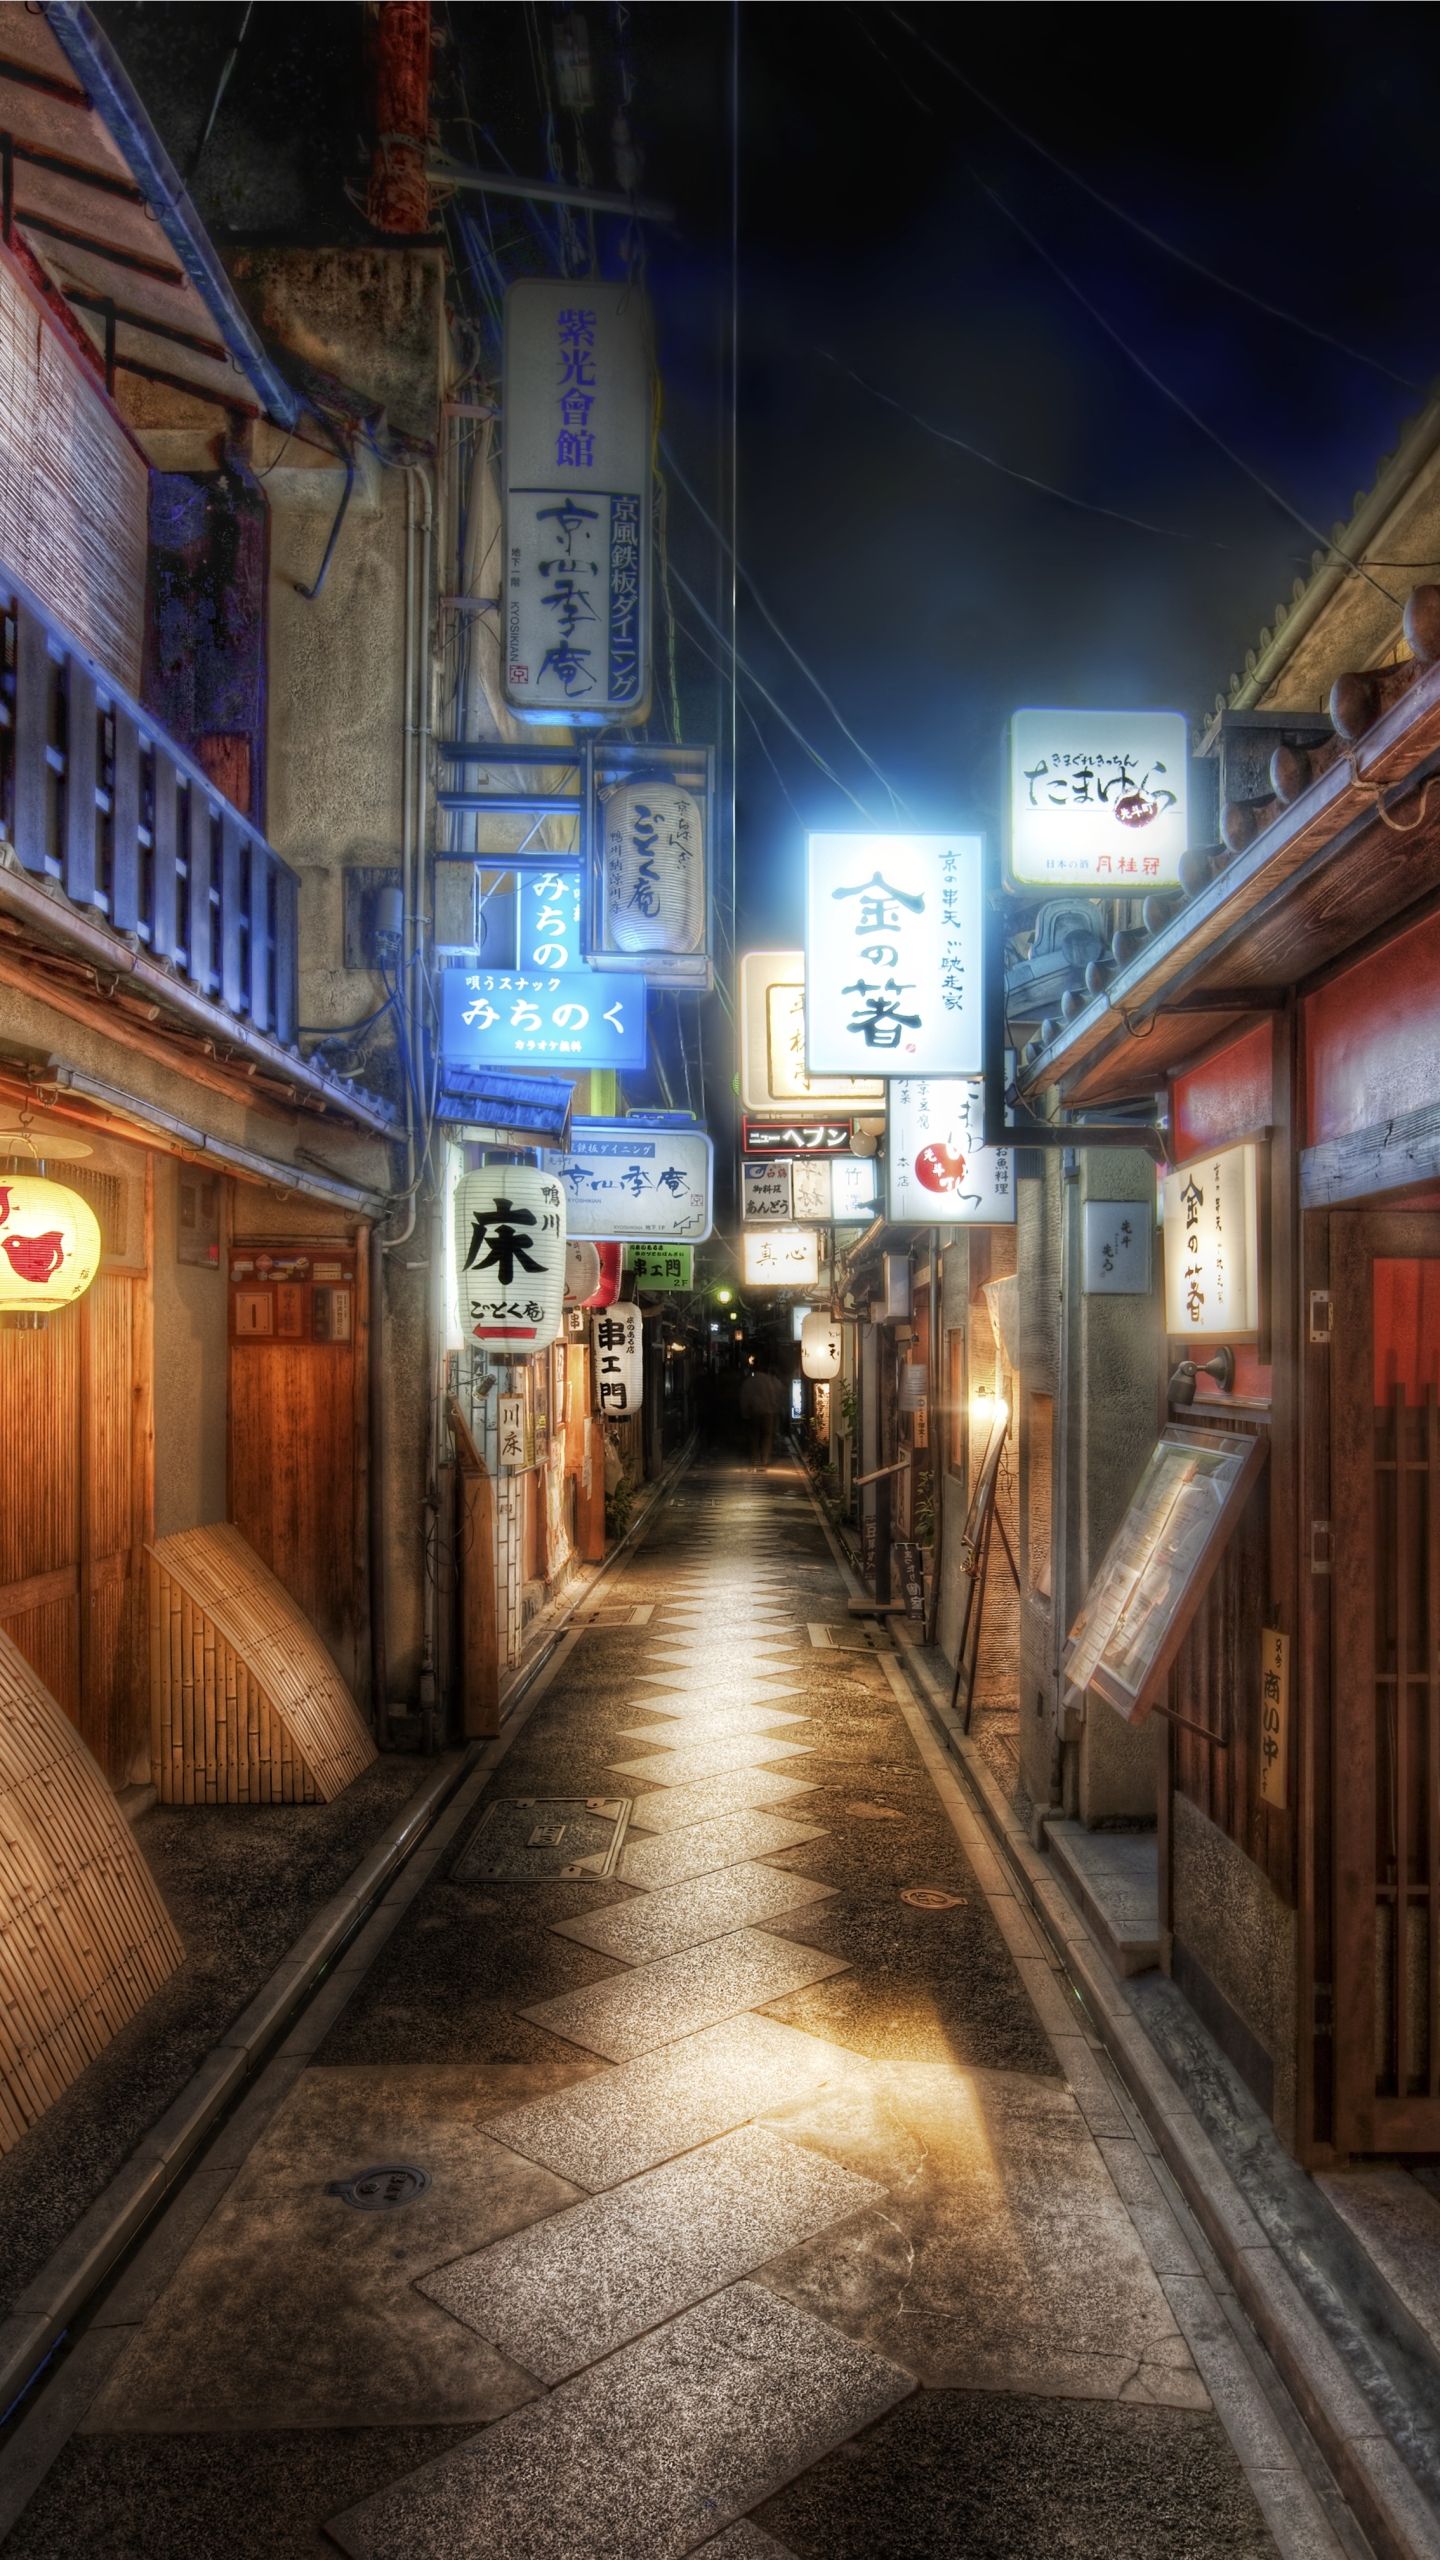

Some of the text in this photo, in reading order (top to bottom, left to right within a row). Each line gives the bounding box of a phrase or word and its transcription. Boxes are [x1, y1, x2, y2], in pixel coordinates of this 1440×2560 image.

[556, 309, 597, 468] 紫光會館
[610, 495, 640, 699] 京風鉄板ダイニング
[1096, 855, 1160, 876] 月桂冠
[938, 850, 963, 928] 京の串天
[465, 975, 561, 992] 唄うスナック
[461, 998, 625, 1034] みちのく
[571, 1144, 652, 1155] 鉄板ダイニング
[753, 1184, 782, 1194] 御料理
[541, 1184, 560, 1239] 鴨川
[746, 1199, 789, 1215] あんどう
[462, 1198, 549, 1285] 床
[756, 1242, 807, 1266] 真心
[674, 1279, 688, 1287] 2F
[471, 1300, 546, 1321] ごとく庵
[502, 1403, 522, 1457] 川床
